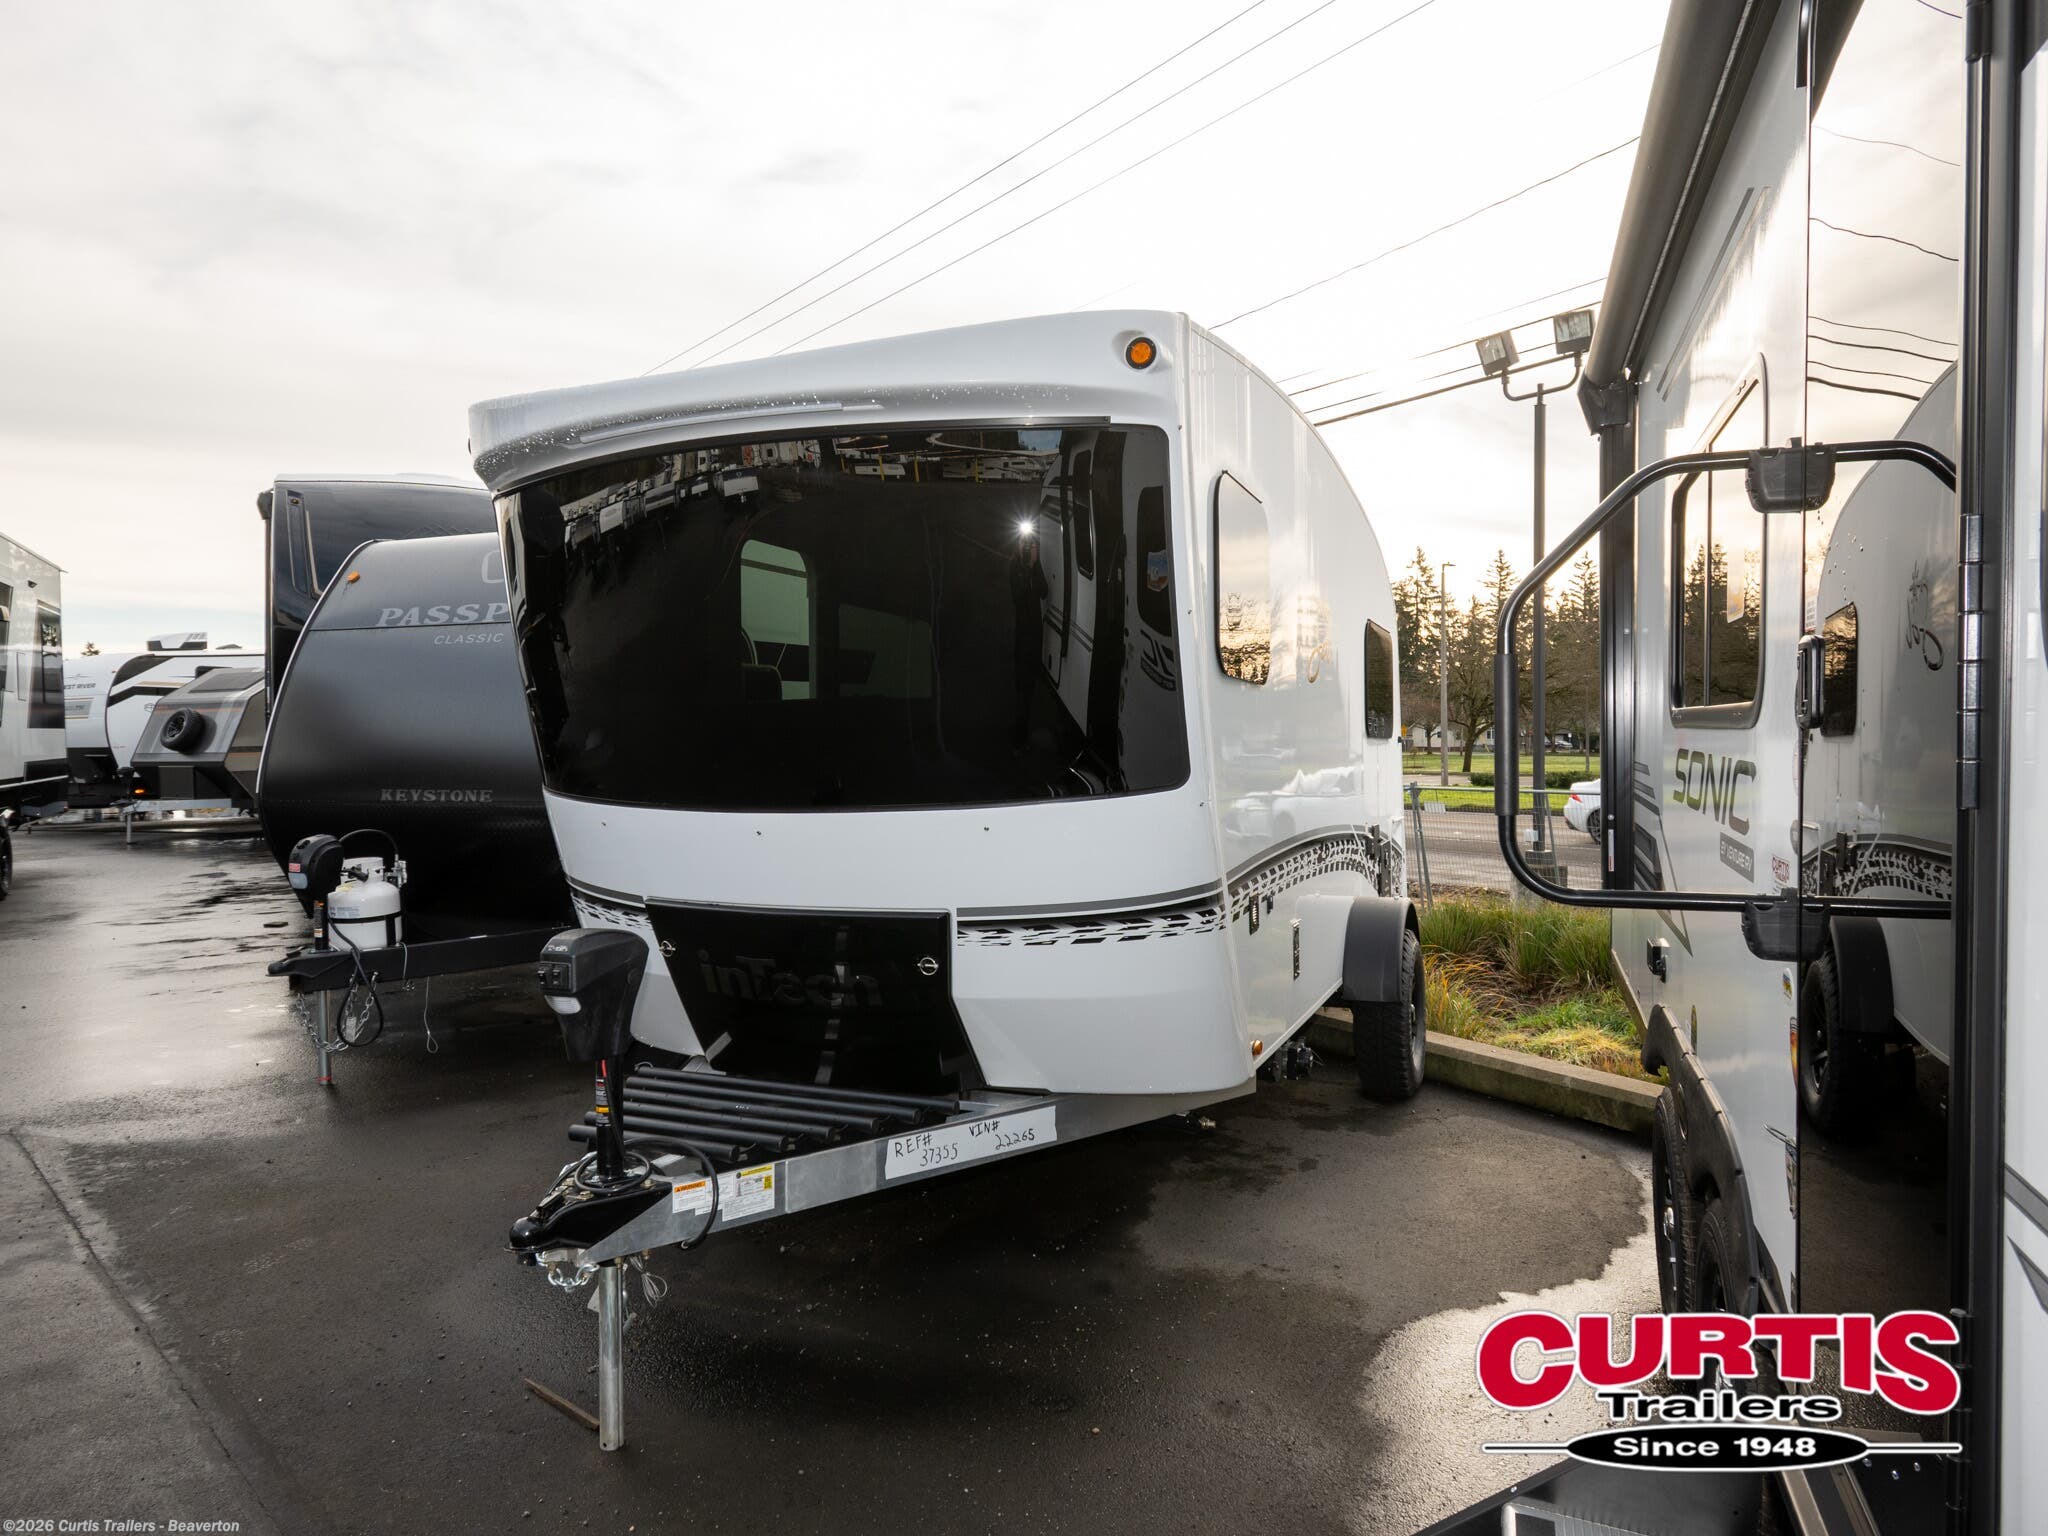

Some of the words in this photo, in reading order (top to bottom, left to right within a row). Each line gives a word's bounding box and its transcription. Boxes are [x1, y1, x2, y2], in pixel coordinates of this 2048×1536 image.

[375, 602, 510, 628] PASSP
[433, 633, 505, 646] CLASSIC
[380, 788, 494, 803] KEYSTONE
[1672, 747, 1757, 837] SONIC
[696, 949, 883, 1007] inTech
[894, 1132, 933, 1158] REF#
[968, 1119, 1002, 1138] VIN#
[919, 1142, 959, 1167] 37355
[994, 1128, 1036, 1151] 22265
